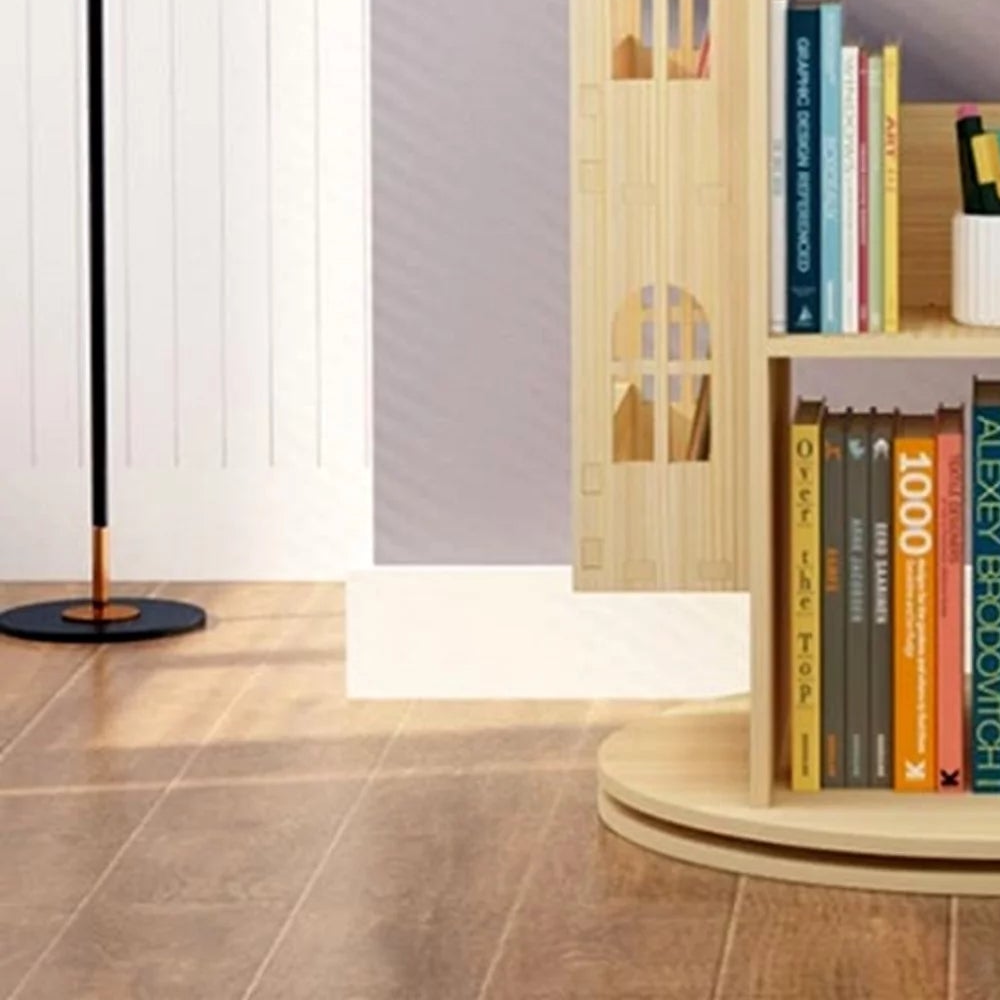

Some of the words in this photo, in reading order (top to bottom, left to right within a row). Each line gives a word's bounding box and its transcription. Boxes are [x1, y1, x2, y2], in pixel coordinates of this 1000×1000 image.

[796, 37, 811, 106] GRAPHIC
[796, 110, 811, 167] DESIGN
[796, 171, 811, 273] REFERENCED
[899, 452, 933, 556] 1000
